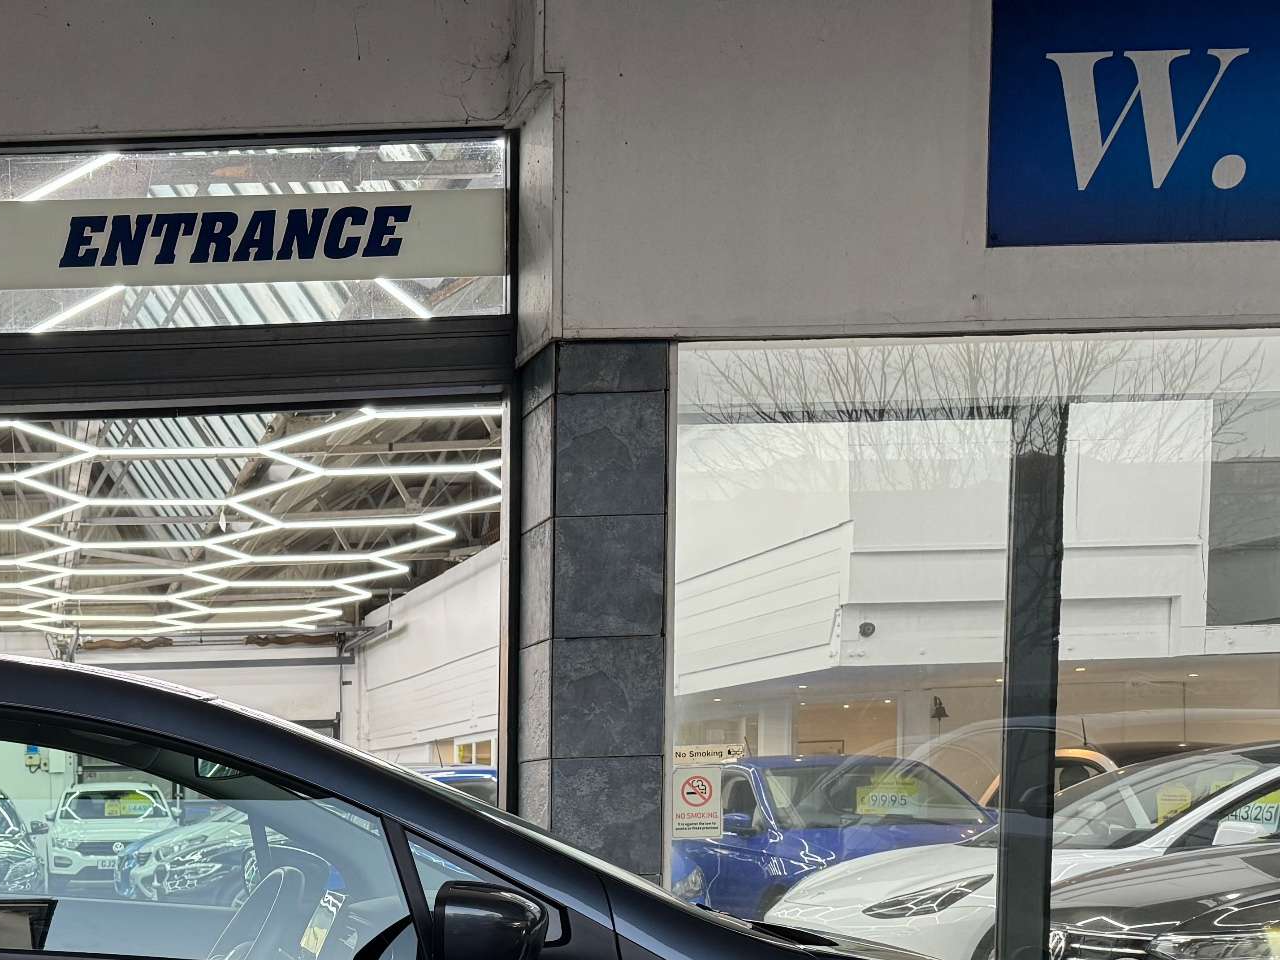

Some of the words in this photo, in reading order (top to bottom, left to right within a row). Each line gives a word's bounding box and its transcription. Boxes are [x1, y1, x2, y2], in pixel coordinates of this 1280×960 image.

[58, 205, 412, 268] ENTRANCE
[689, 750, 723, 759] Smoking
[686, 811, 718, 820] SMOKING
